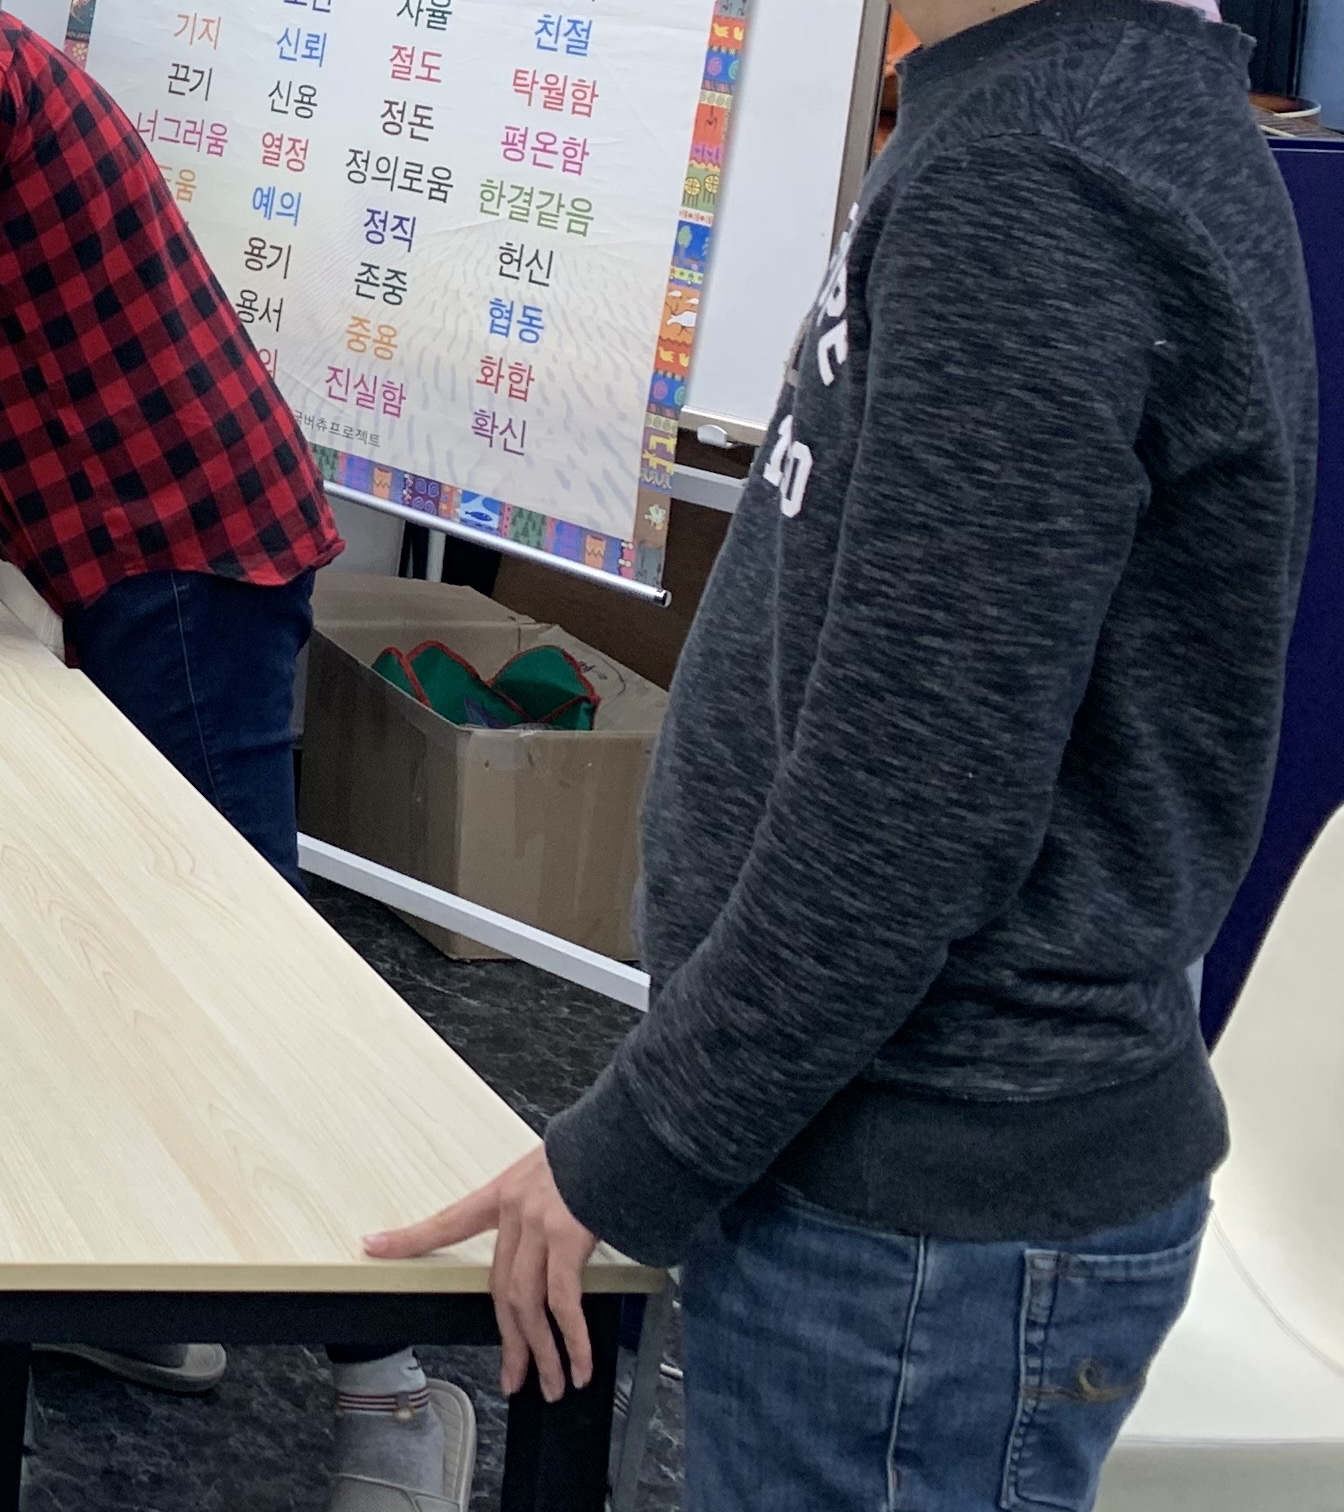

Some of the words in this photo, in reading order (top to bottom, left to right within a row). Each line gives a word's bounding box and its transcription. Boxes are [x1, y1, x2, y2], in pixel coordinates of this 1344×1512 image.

[173, 12, 221, 50] 기지
[275, 27, 328, 68] 신뢰
[534, 13, 593, 58] 친절
[167, 62, 213, 102] 끈기
[389, 44, 443, 84] 절도
[267, 79, 318, 120] 신용
[512, 68, 600, 118] 탁월함
[136, 109, 229, 158] 너그러움
[380, 99, 435, 143] 정돈
[261, 131, 309, 173] 열정
[500, 125, 590, 176] 평온함
[345, 148, 454, 204] 정의로움
[251, 185, 302, 227] 예의
[479, 178, 595, 238] 한결같음
[363, 207, 417, 254] 정직
[243, 236, 292, 280] 용기
[498, 241, 554, 288] 헌신
[353, 261, 408, 306] 존중
[234, 289, 284, 332] 용서
[488, 297, 545, 344] 협동
[345, 315, 398, 361] 중용
[324, 365, 408, 418] 진실함
[475, 355, 536, 403] 화합
[471, 408, 527, 457] 확신
